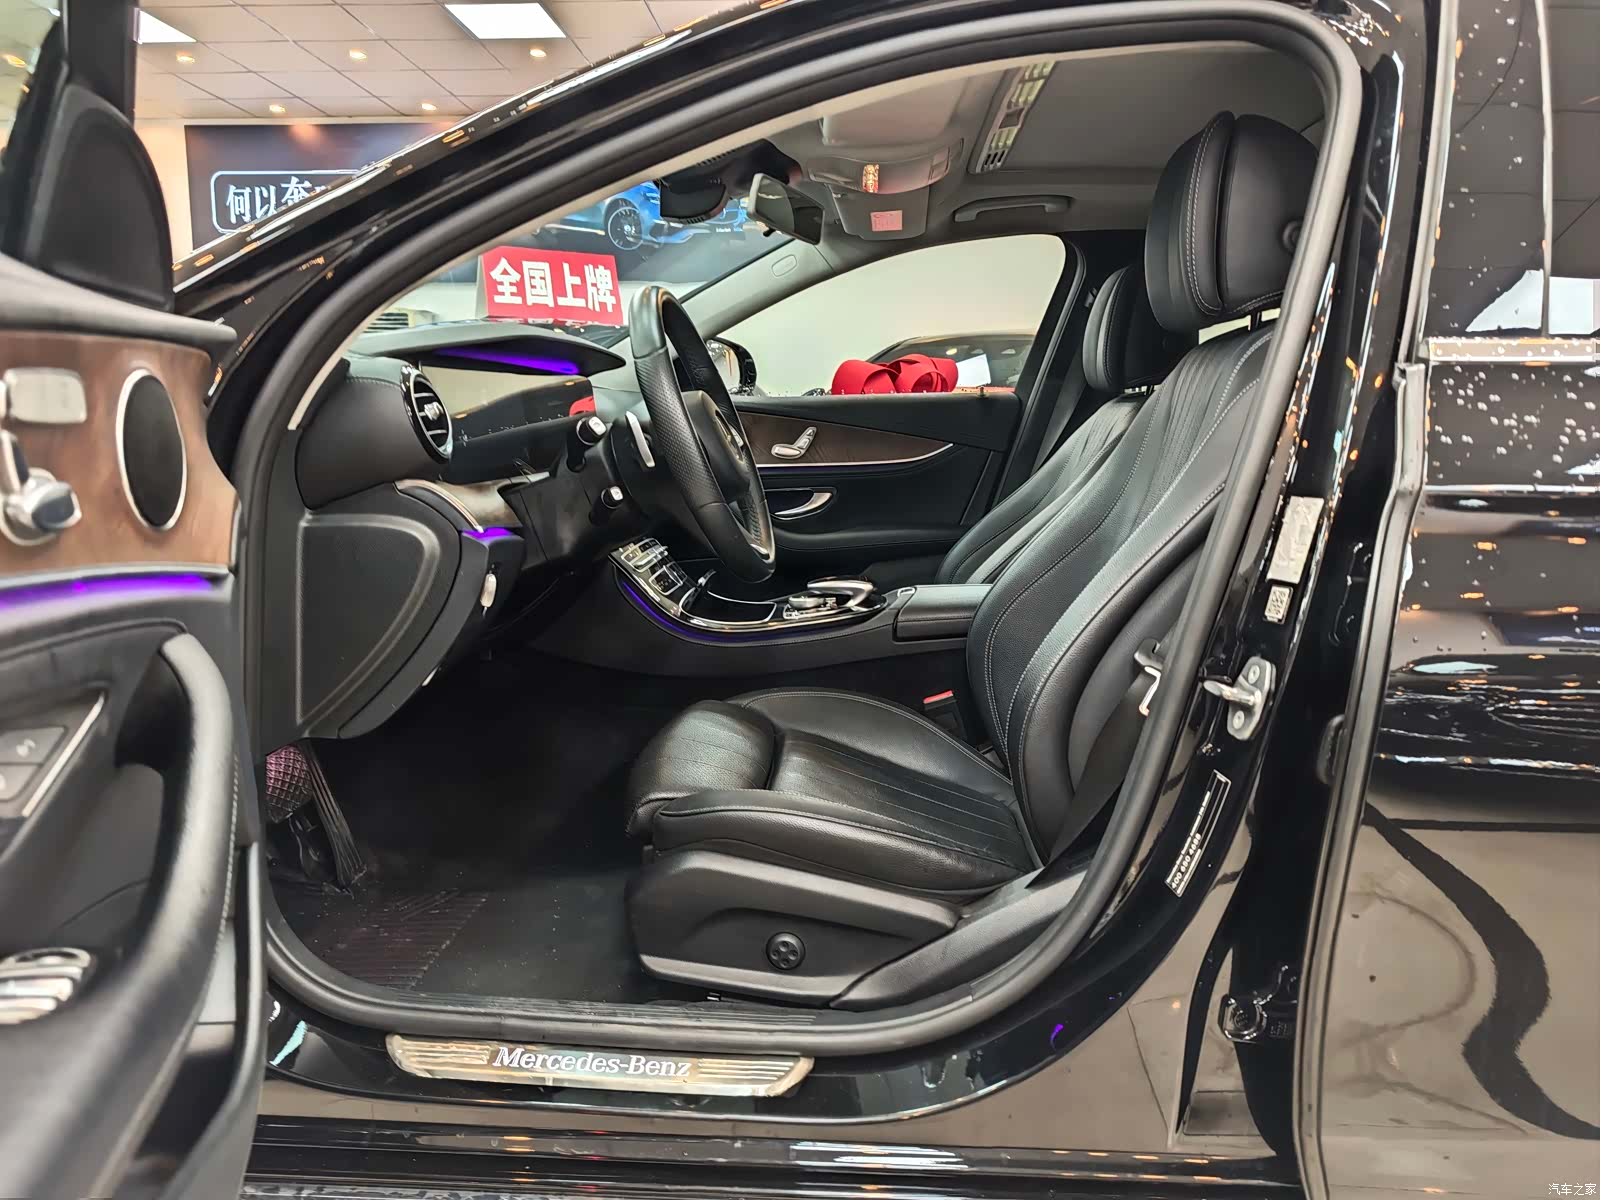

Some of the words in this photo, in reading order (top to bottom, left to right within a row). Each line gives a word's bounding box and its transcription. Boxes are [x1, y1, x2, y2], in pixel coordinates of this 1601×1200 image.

[489, 256, 617, 313] 全国上牌
[1171, 872, 1183, 889] 400
[492, 1046, 691, 1077] Mercedes-Benz
